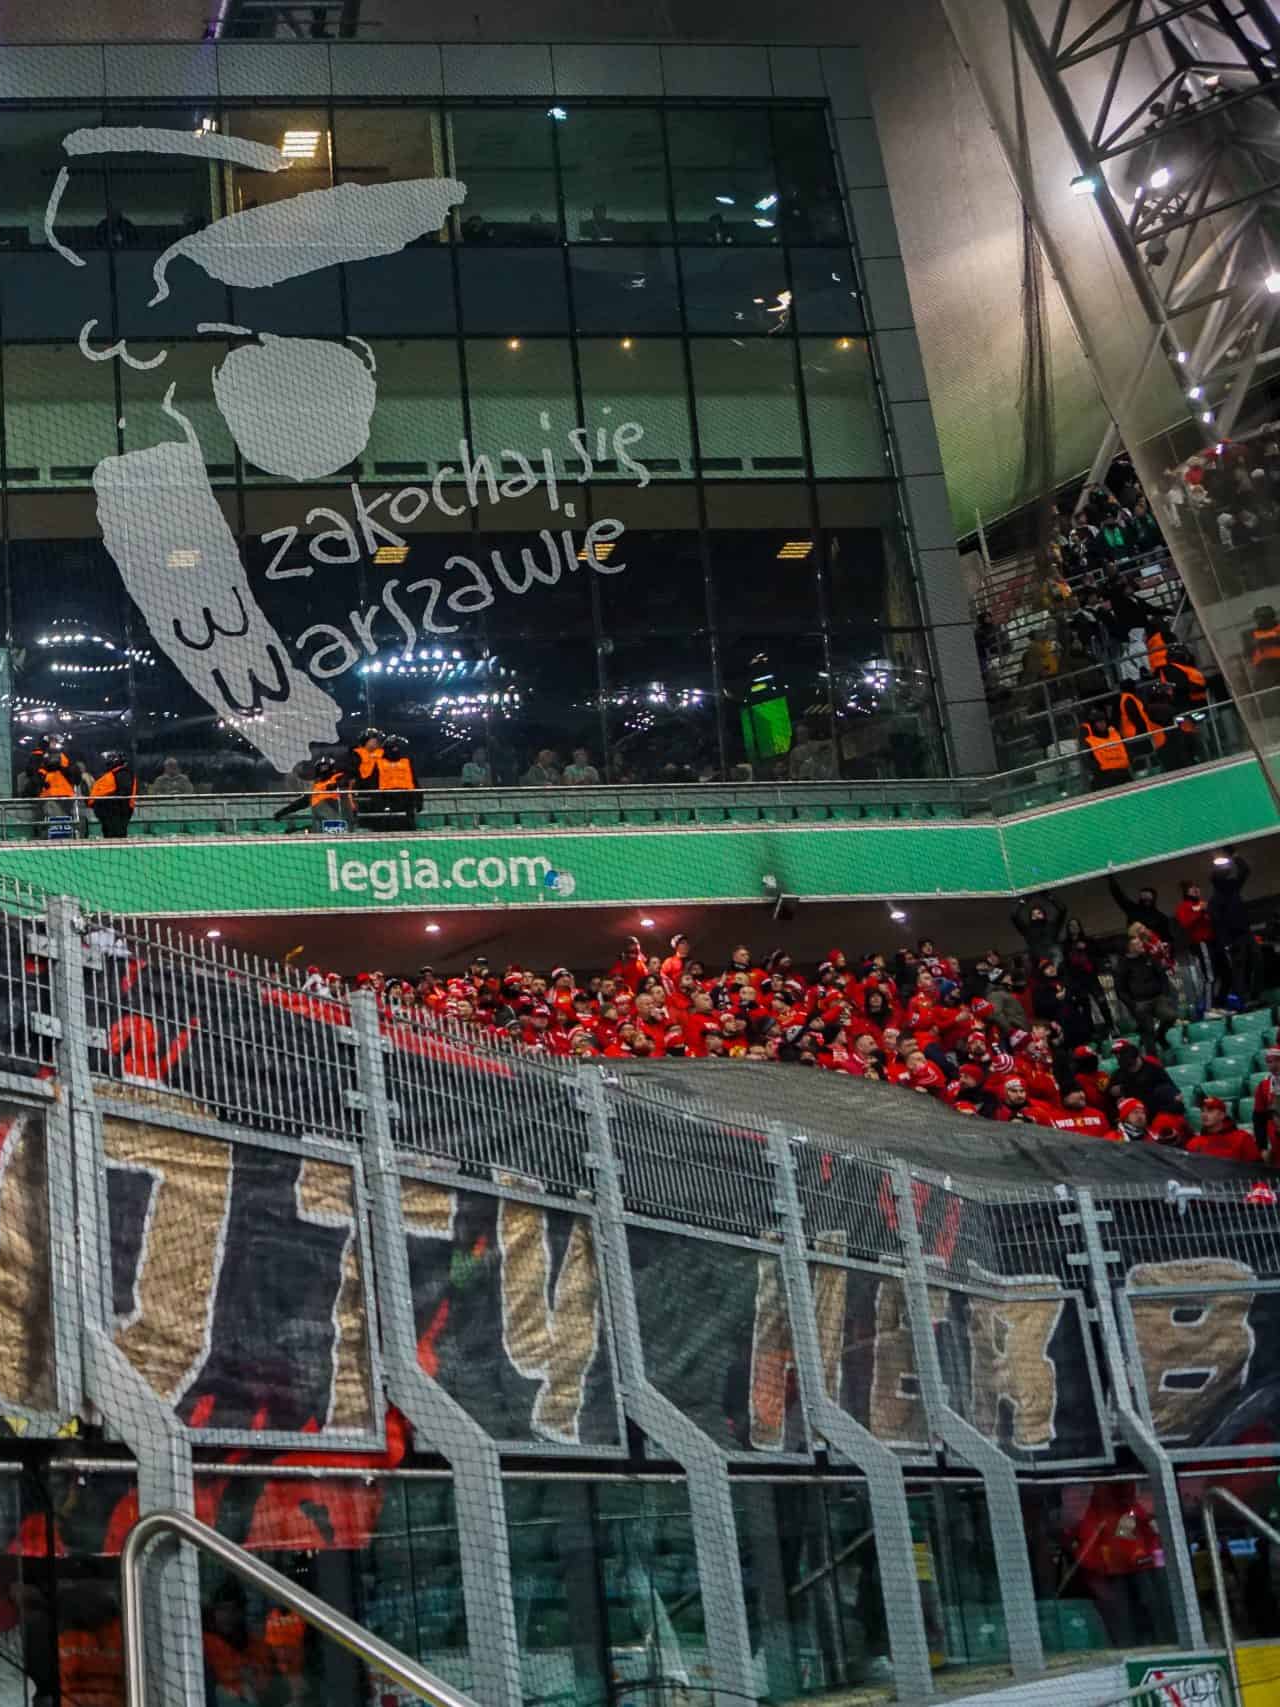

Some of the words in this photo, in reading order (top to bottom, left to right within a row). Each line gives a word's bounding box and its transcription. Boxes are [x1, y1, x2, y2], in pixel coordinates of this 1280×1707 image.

[261, 410, 561, 580] zakochaj
[567, 406, 651, 488] się
[326, 849, 554, 901] legia.com
